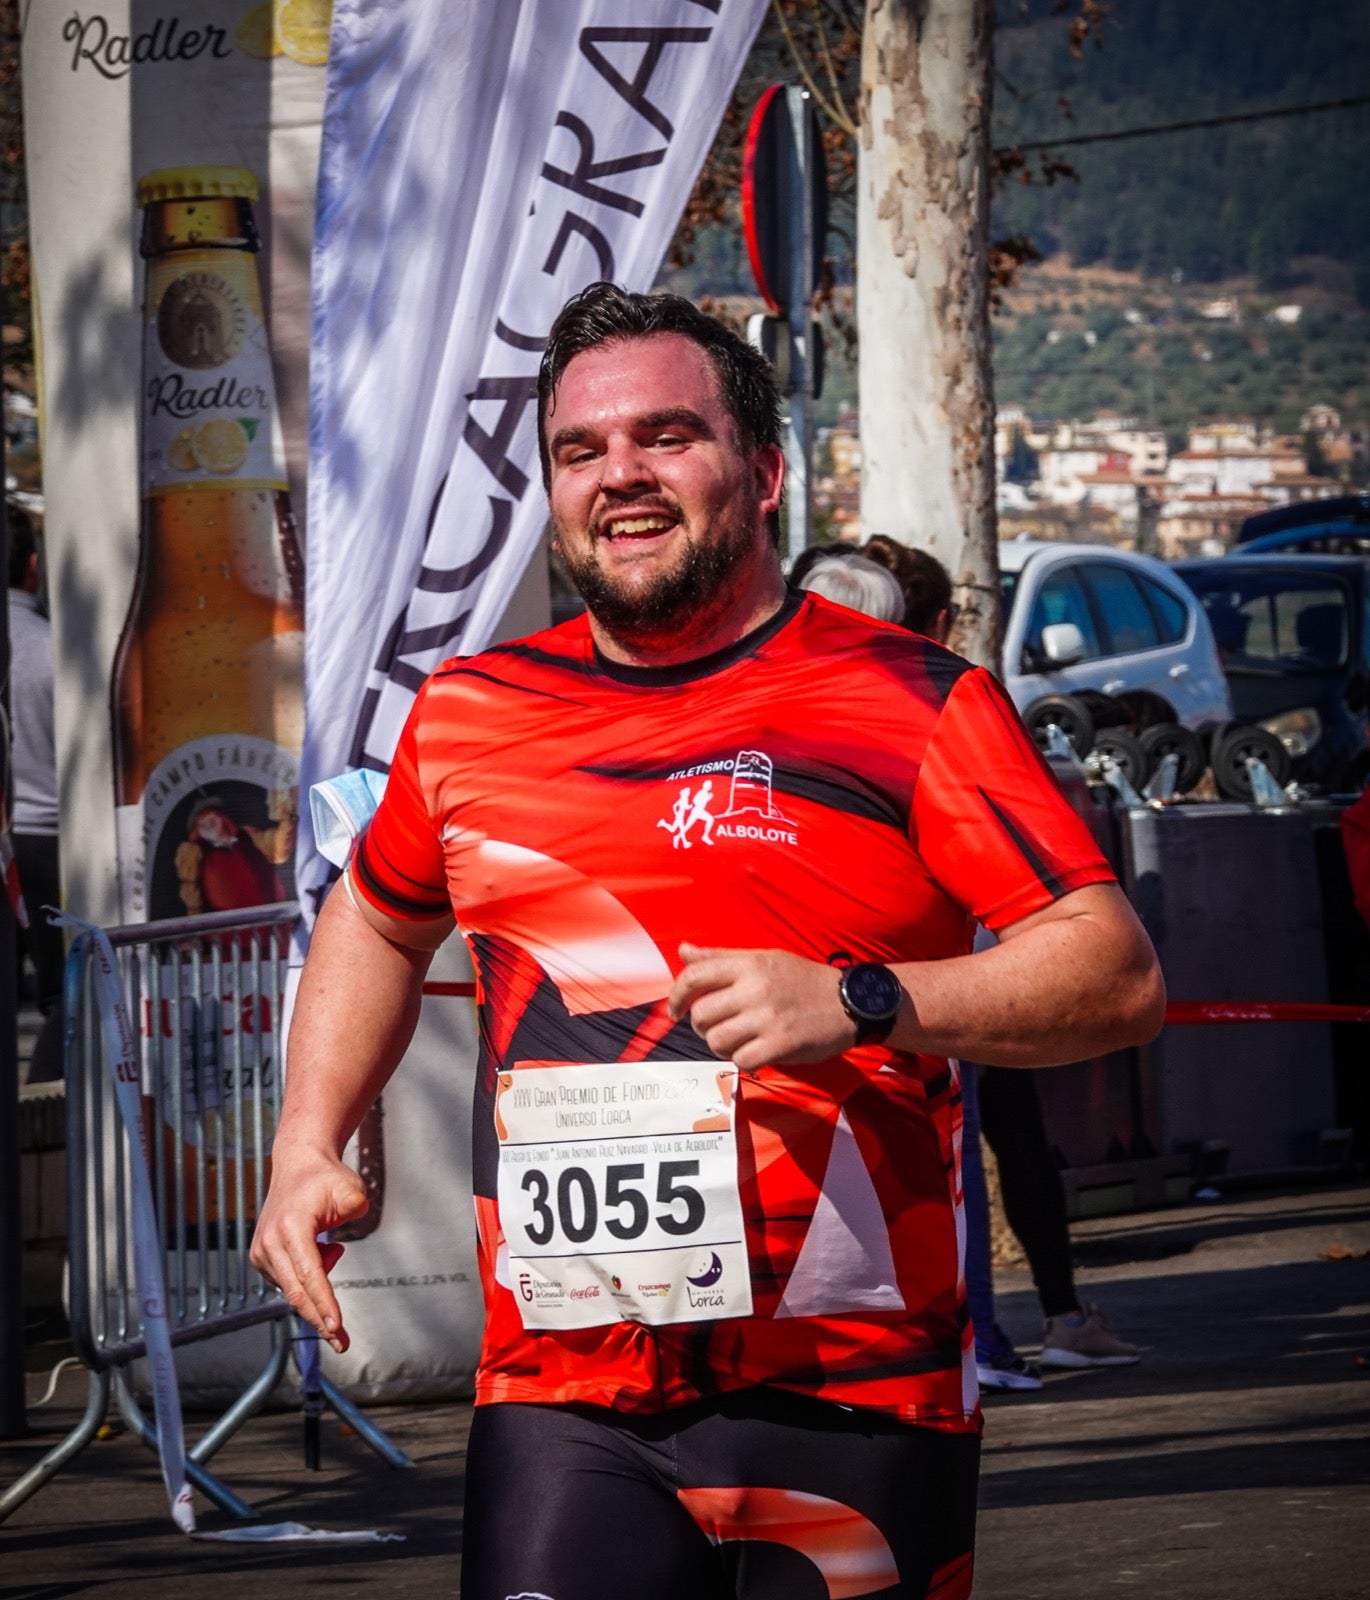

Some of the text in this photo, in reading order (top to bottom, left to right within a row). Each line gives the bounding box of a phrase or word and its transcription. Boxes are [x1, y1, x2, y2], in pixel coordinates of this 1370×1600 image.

[62, 10, 233, 80] Radler
[148, 373, 270, 419] Radler
[665, 759, 734, 782] ATLETISMO
[716, 824, 798, 845] ALBOLOTE
[534, 1087, 557, 1107] GRAN
[559, 1085, 598, 1105] PREMIO
[604, 1086, 617, 1103] DE
[622, 1082, 659, 1101] FONDO
[555, 1108, 632, 1128] UNIVERSO LORCA
[674, 1141, 684, 1153] DE
[521, 1160, 706, 1245] 3055
[686, 1285, 725, 1308] Lorca
